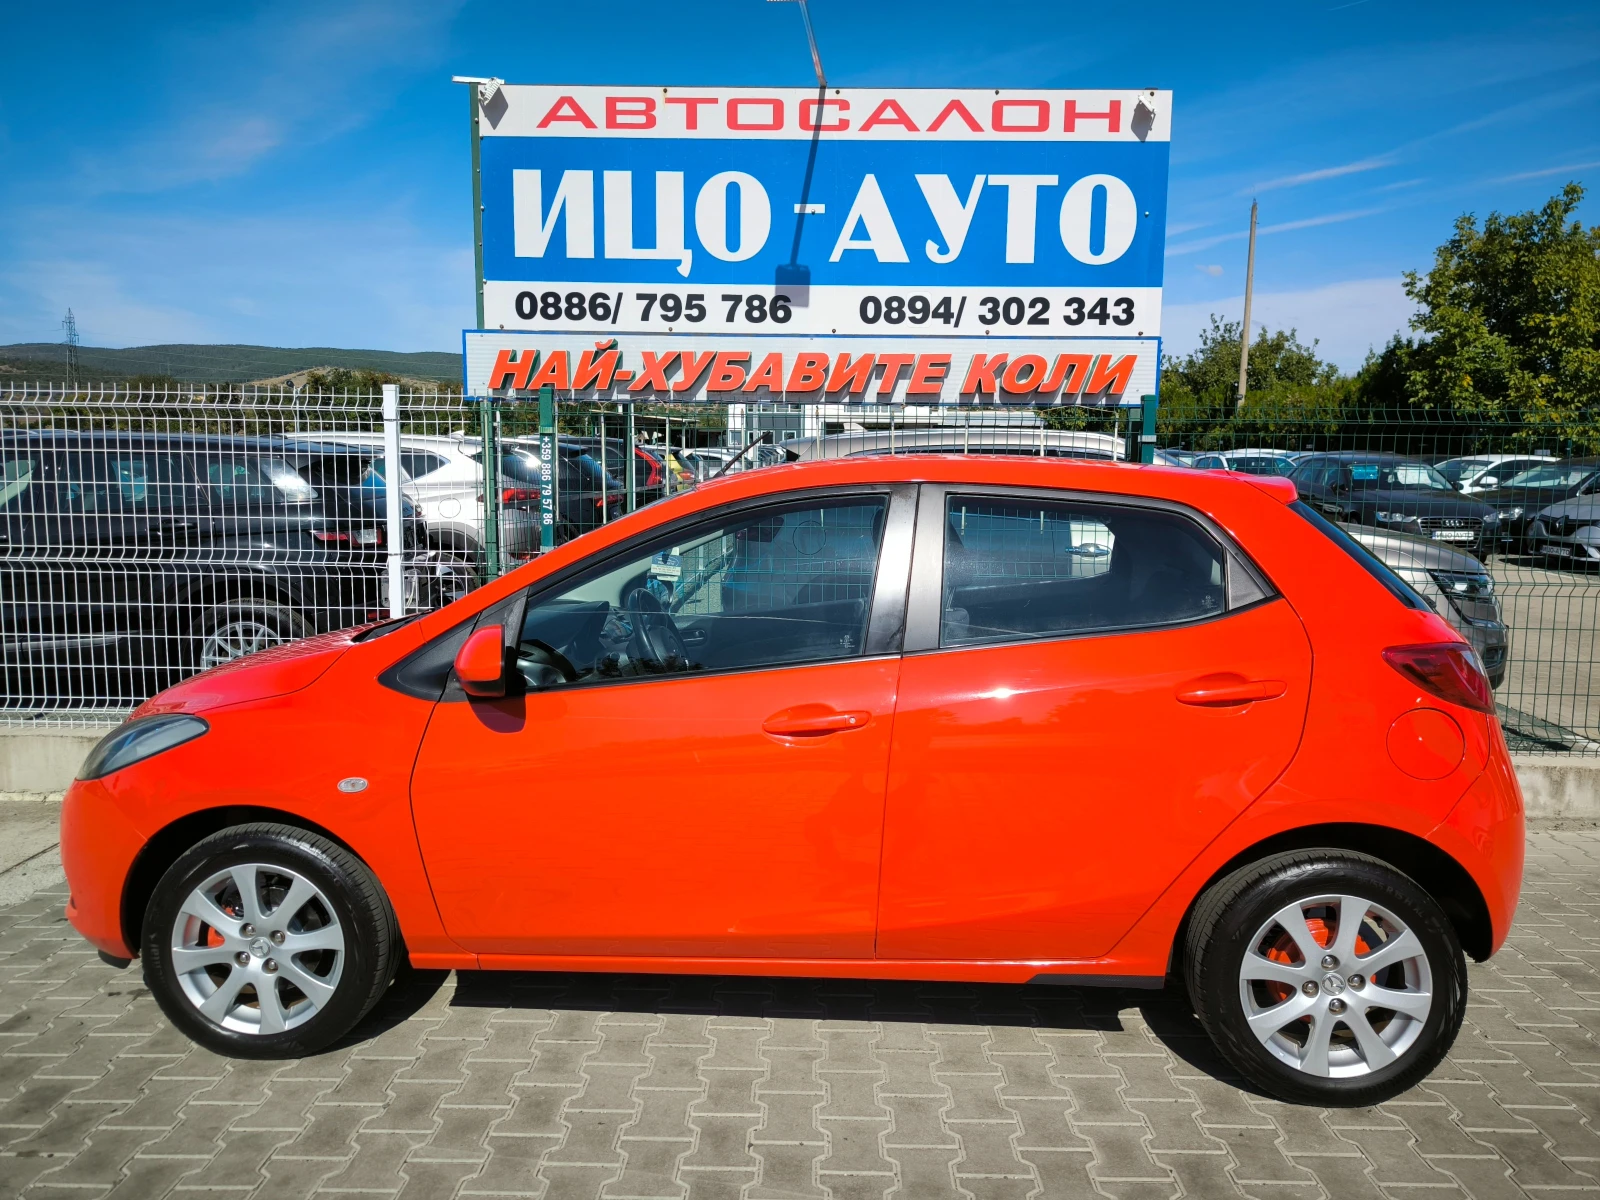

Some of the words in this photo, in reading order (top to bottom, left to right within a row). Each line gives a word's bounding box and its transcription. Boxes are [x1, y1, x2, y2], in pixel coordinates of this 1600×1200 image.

[538, 97, 1121, 132] АВТОСАЛОН
[516, 291, 622, 325] 0886/
[637, 293, 706, 323] 795
[722, 294, 791, 323] 786
[860, 296, 966, 328] 0894/
[979, 296, 1049, 326] 302
[1064, 297, 1134, 326] 343
[488, 339, 951, 395] НАЙ-ХУБАВИТЕ
[961, 353, 1138, 396] КОЛИ
[541, 436, 552, 460] +359
[541, 463, 552, 481] 886
[541, 484, 552, 496] 79
[542, 498, 553, 511] 57
[543, 512, 553, 525] 86
